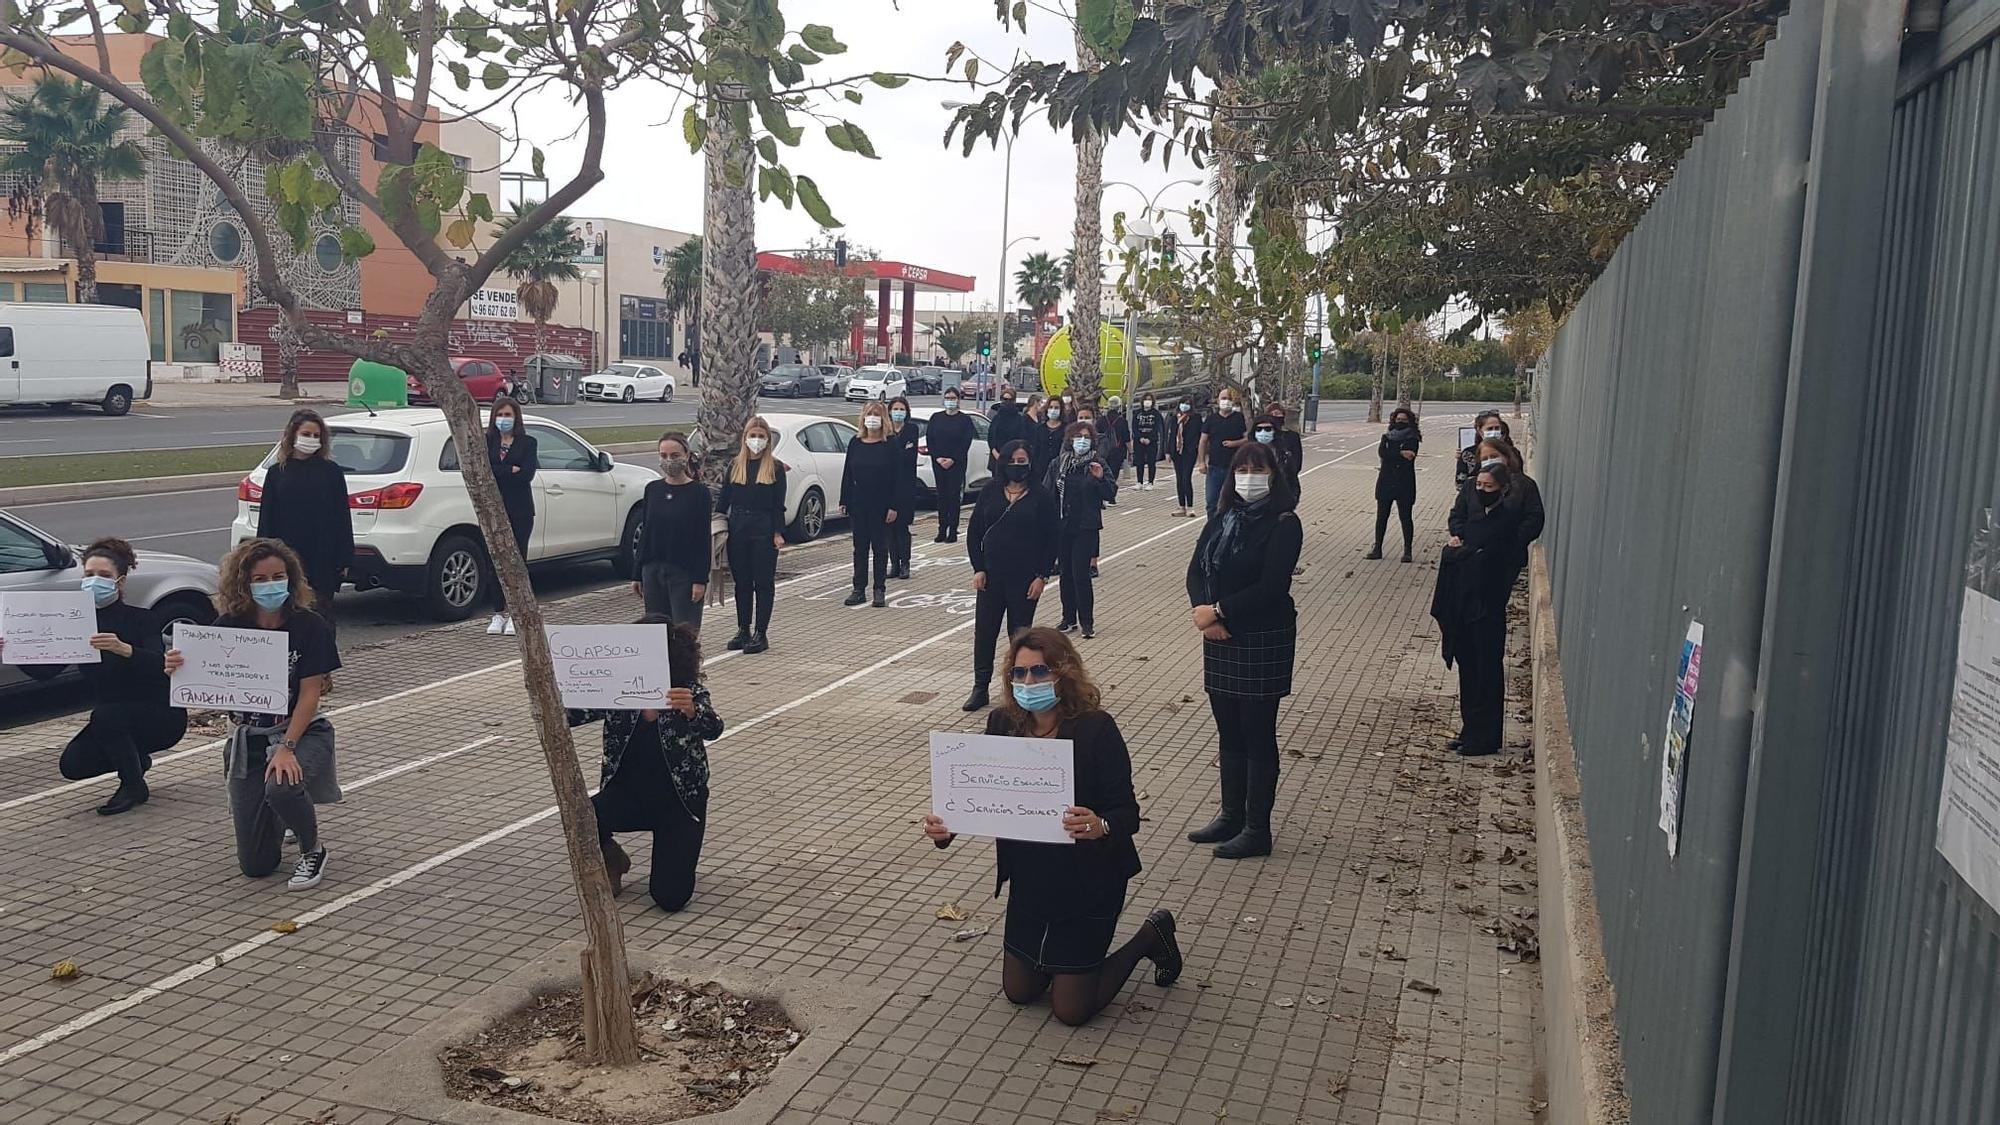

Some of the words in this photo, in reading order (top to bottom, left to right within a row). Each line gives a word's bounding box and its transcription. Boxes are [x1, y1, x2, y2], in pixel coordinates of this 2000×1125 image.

[908, 265, 928, 280] CEPSA
[472, 290, 484, 300] SE
[487, 290, 517, 304] VENDE
[478, 304, 487, 315] 96
[488, 305, 498, 317] 627
[500, 306, 508, 317] 62
[509, 306, 517, 318] 09
[549, 632, 621, 659] COLAPSO
